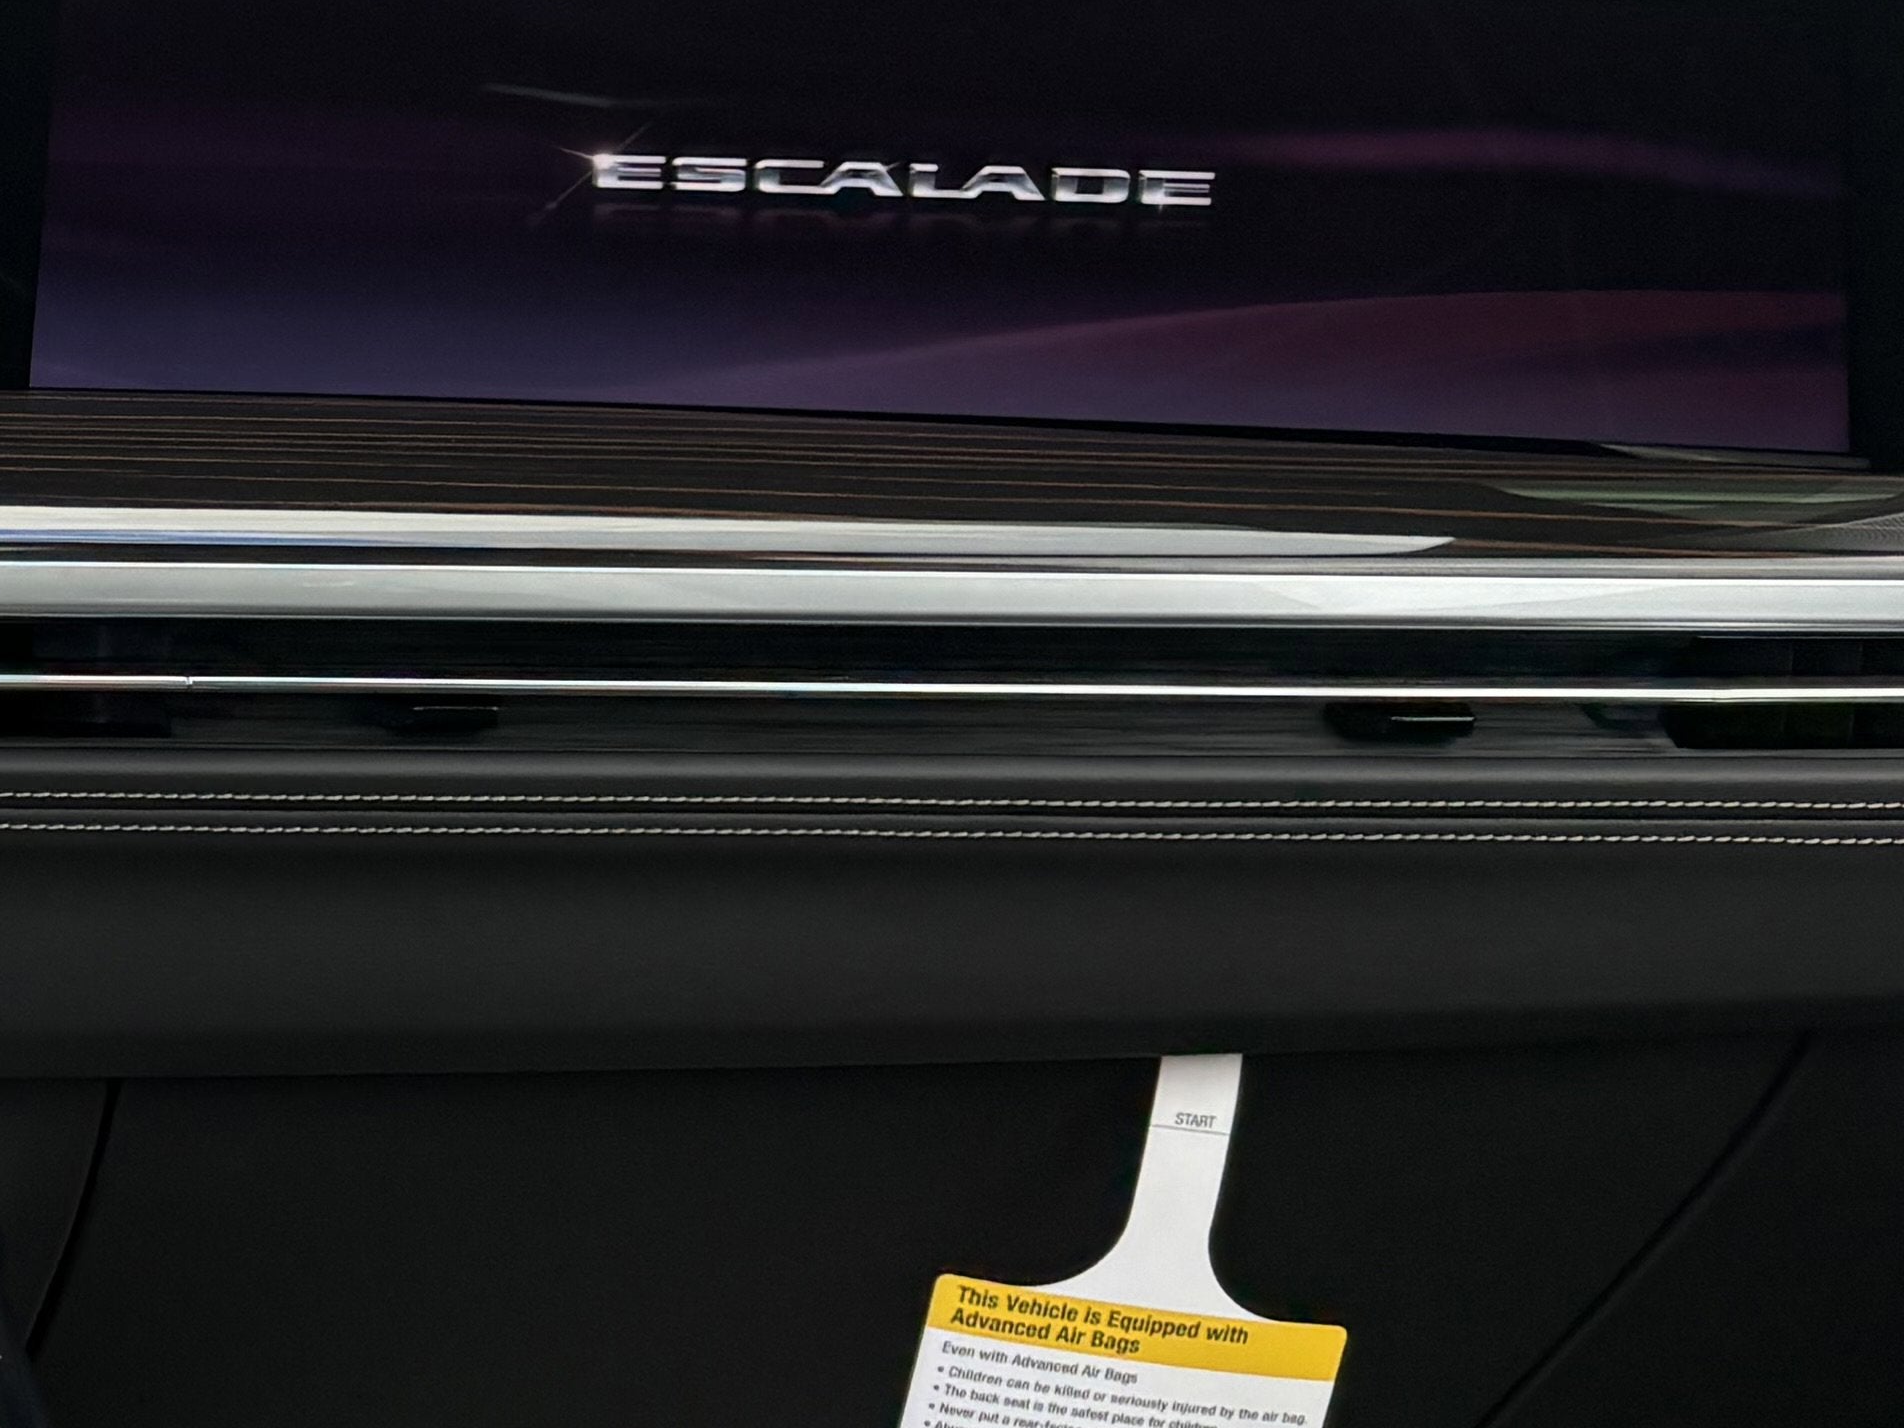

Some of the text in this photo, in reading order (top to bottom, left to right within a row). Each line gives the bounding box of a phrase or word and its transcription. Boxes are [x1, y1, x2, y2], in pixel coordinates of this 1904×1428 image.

[593, 153, 1216, 208] ESCALADE
[1174, 1112, 1217, 1130] START
[949, 1306, 1141, 1356] Advanced Air Bags
[958, 1284, 1249, 1346] This Vehicle is Equipped with
[941, 1340, 1139, 1385] Even with Advanced Air Bags
[939, 1402, 977, 1419] Never
[978, 1409, 1000, 1425] put
[1002, 1415, 1011, 1425] a
[944, 1382, 967, 1399] The
[970, 1387, 1000, 1404] back
[1003, 1395, 1031, 1411] seat
[1033, 1400, 1045, 1412] is
[1047, 1401, 1068, 1416] the
[1071, 1405, 1109, 1422] safest
[1111, 1411, 1145, 1428] place
[1148, 1415, 1166, 1428] for
[948, 1364, 1003, 1387] Children
[1006, 1376, 1030, 1391] can
[1033, 1380, 1051, 1394] be
[1054, 1382, 1091, 1400] killed
[1093, 1391, 1107, 1403] or
[1110, 1393, 1169, 1413] seriously
[1171, 1400, 1217, 1417] injured
[1219, 1406, 1235, 1420] by
[1238, 1408, 1259, 1421] the
[1262, 1410, 1279, 1423] air
